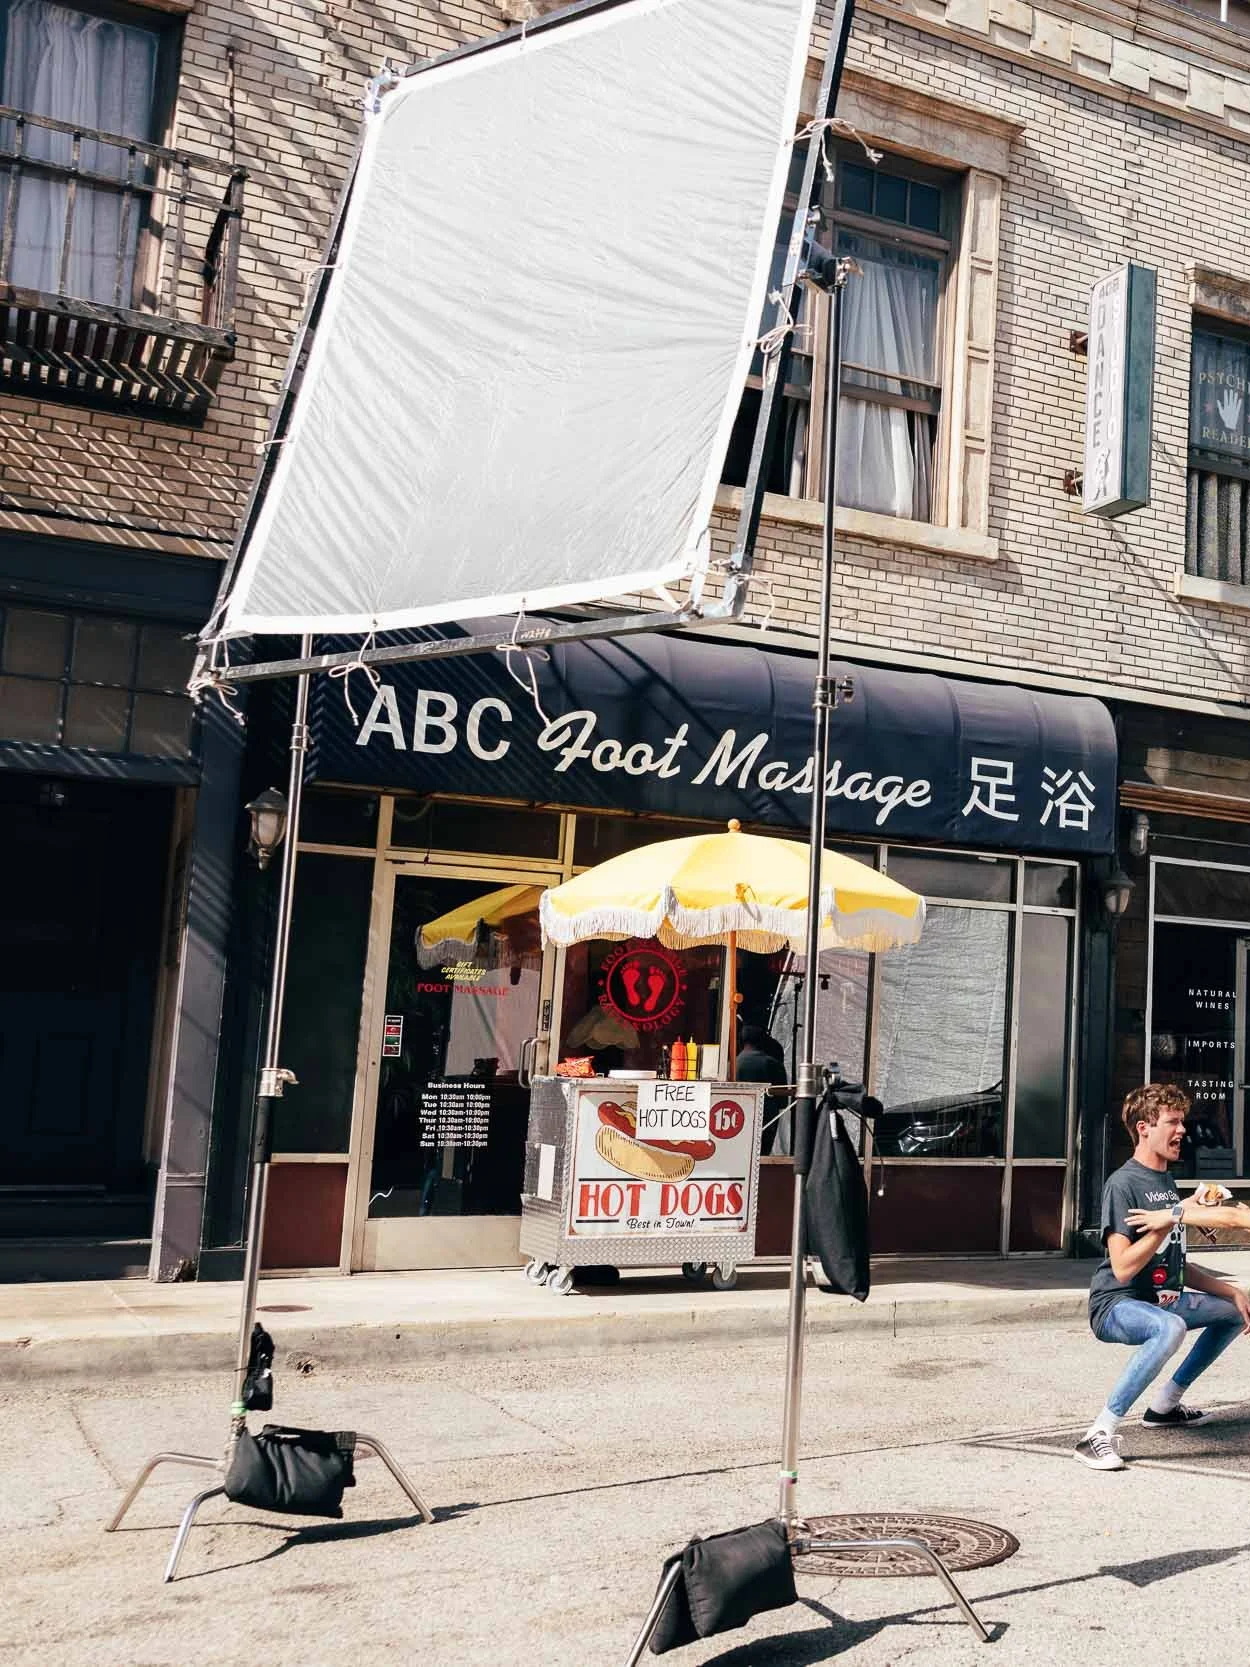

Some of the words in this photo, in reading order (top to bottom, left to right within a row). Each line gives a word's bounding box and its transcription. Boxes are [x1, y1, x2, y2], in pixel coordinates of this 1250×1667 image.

[1093, 303, 1106, 448] DANCE
[1107, 297, 1121, 441] STUDIO
[355, 685, 513, 761] ABC
[537, 710, 690, 779] Foot
[691, 729, 932, 826] Massage
[962, 757, 1096, 831] 足浴
[416, 983, 450, 993] FOOT
[1188, 988, 1236, 998] NATURAL
[1195, 1001, 1230, 1010] WINES
[1188, 1040, 1236, 1049] IMPORTS
[1188, 1080, 1234, 1088] TASTING
[654, 1083, 696, 1102] FREE
[1196, 1092, 1226, 1100] ROOM
[639, 1108, 669, 1128] HOT
[671, 1110, 707, 1129] DOGS
[714, 1108, 738, 1131] 15¢
[578, 1183, 647, 1217] HOT
[660, 1182, 743, 1216] DOGS
[1145, 1191, 1169, 1203] Video
[626, 1217, 651, 1230] Best
[653, 1219, 662, 1229] in
[665, 1217, 696, 1230] Town!
